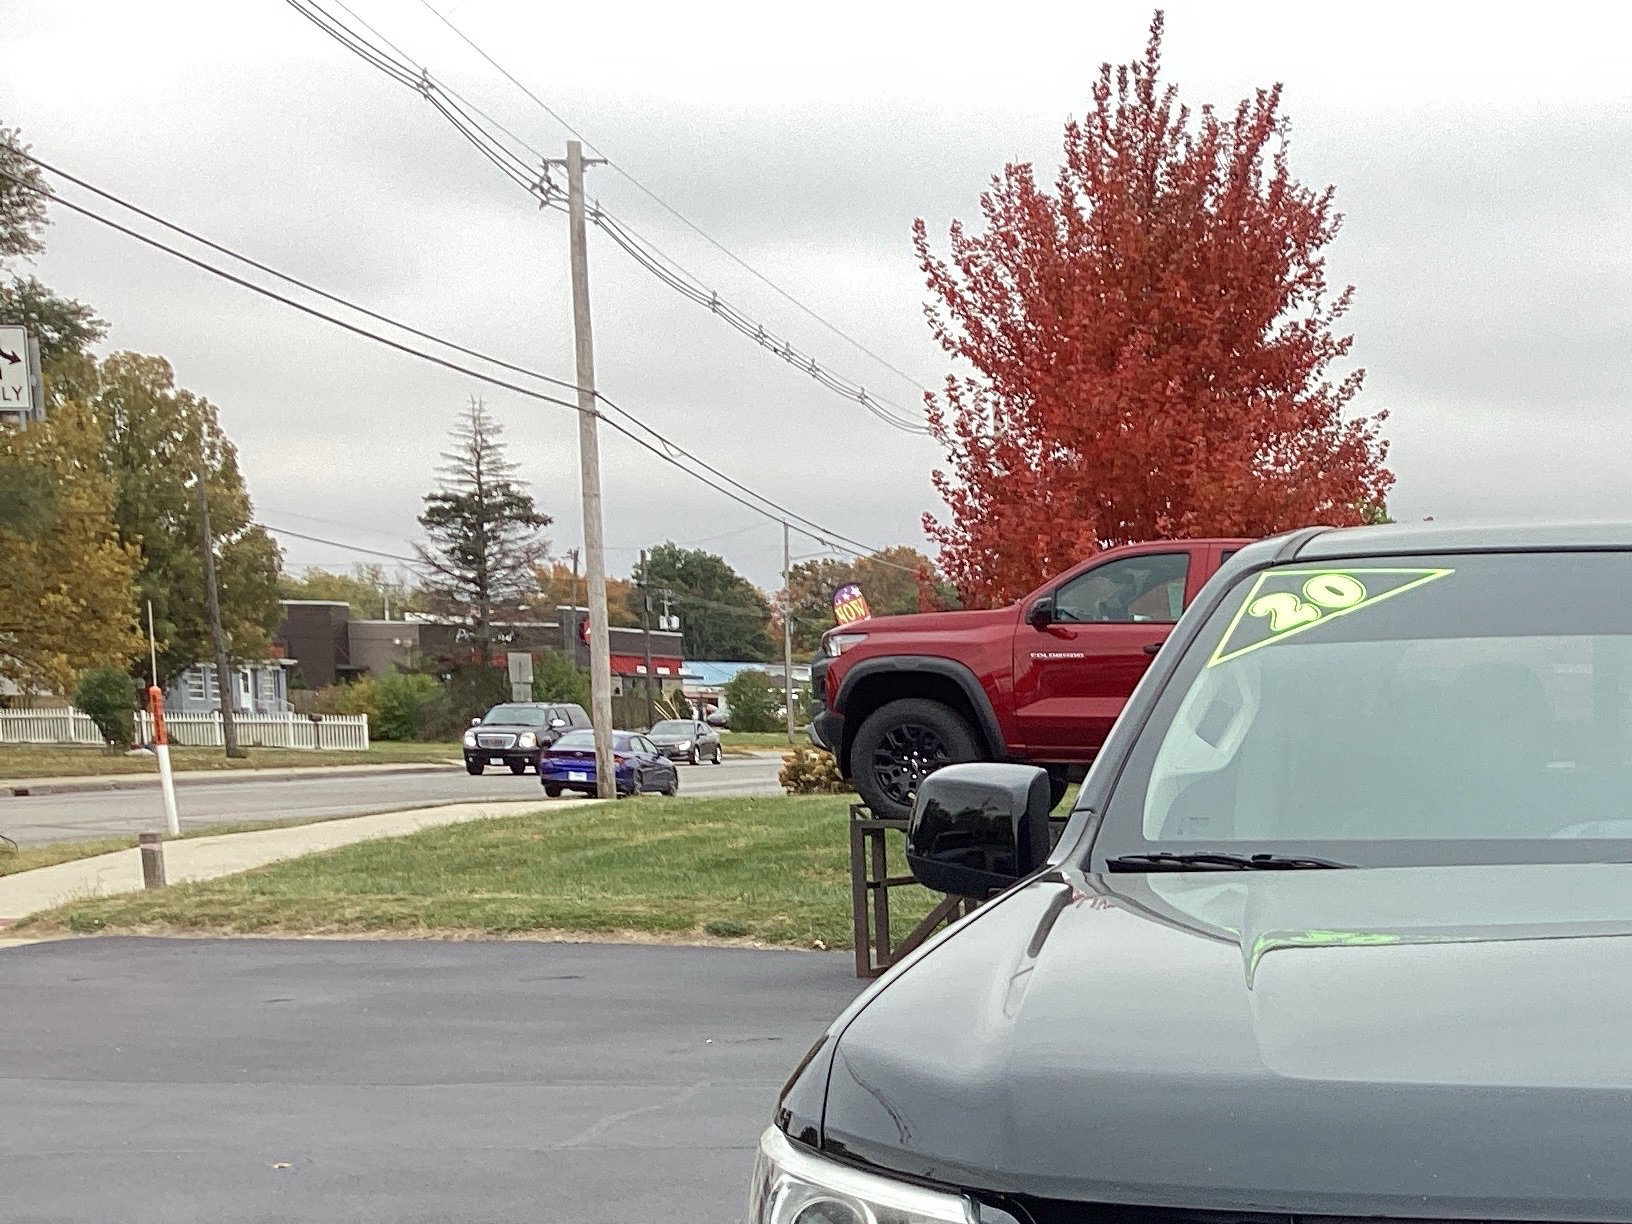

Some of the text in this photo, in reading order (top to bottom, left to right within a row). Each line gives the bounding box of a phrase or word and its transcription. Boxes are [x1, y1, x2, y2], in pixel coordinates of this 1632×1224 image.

[1, 385, 23, 401] LY
[834, 597, 866, 623] NOW
[1248, 573, 1367, 632] 20
